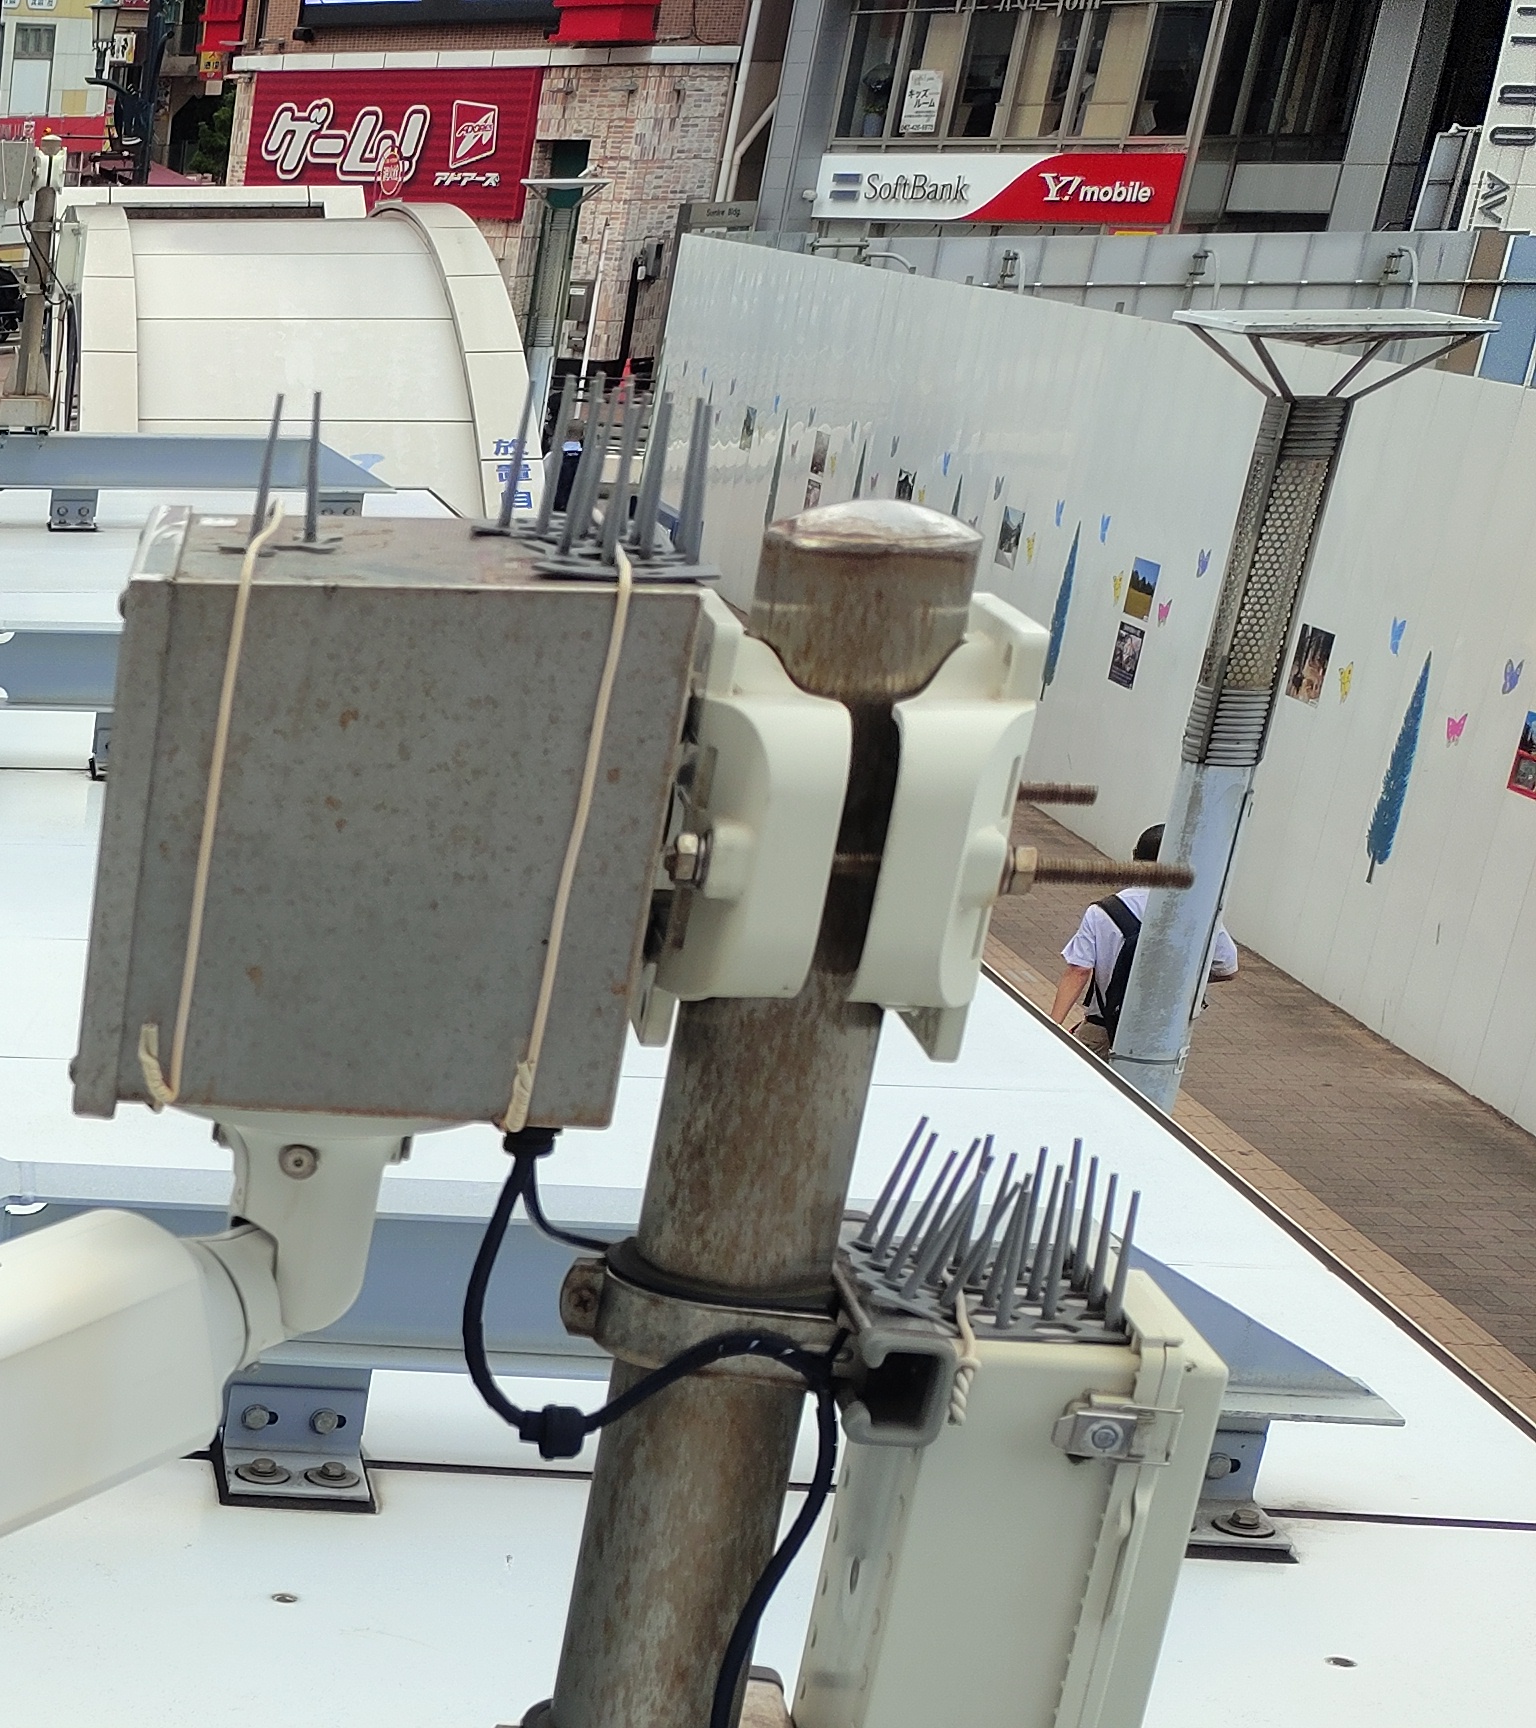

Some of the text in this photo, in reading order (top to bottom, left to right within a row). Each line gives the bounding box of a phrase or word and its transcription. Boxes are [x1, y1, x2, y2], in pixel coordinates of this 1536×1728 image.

[908, 88, 930, 99] キッズ
[914, 98, 935, 108] ルーム
[863, 172, 969, 202] SoftBank
